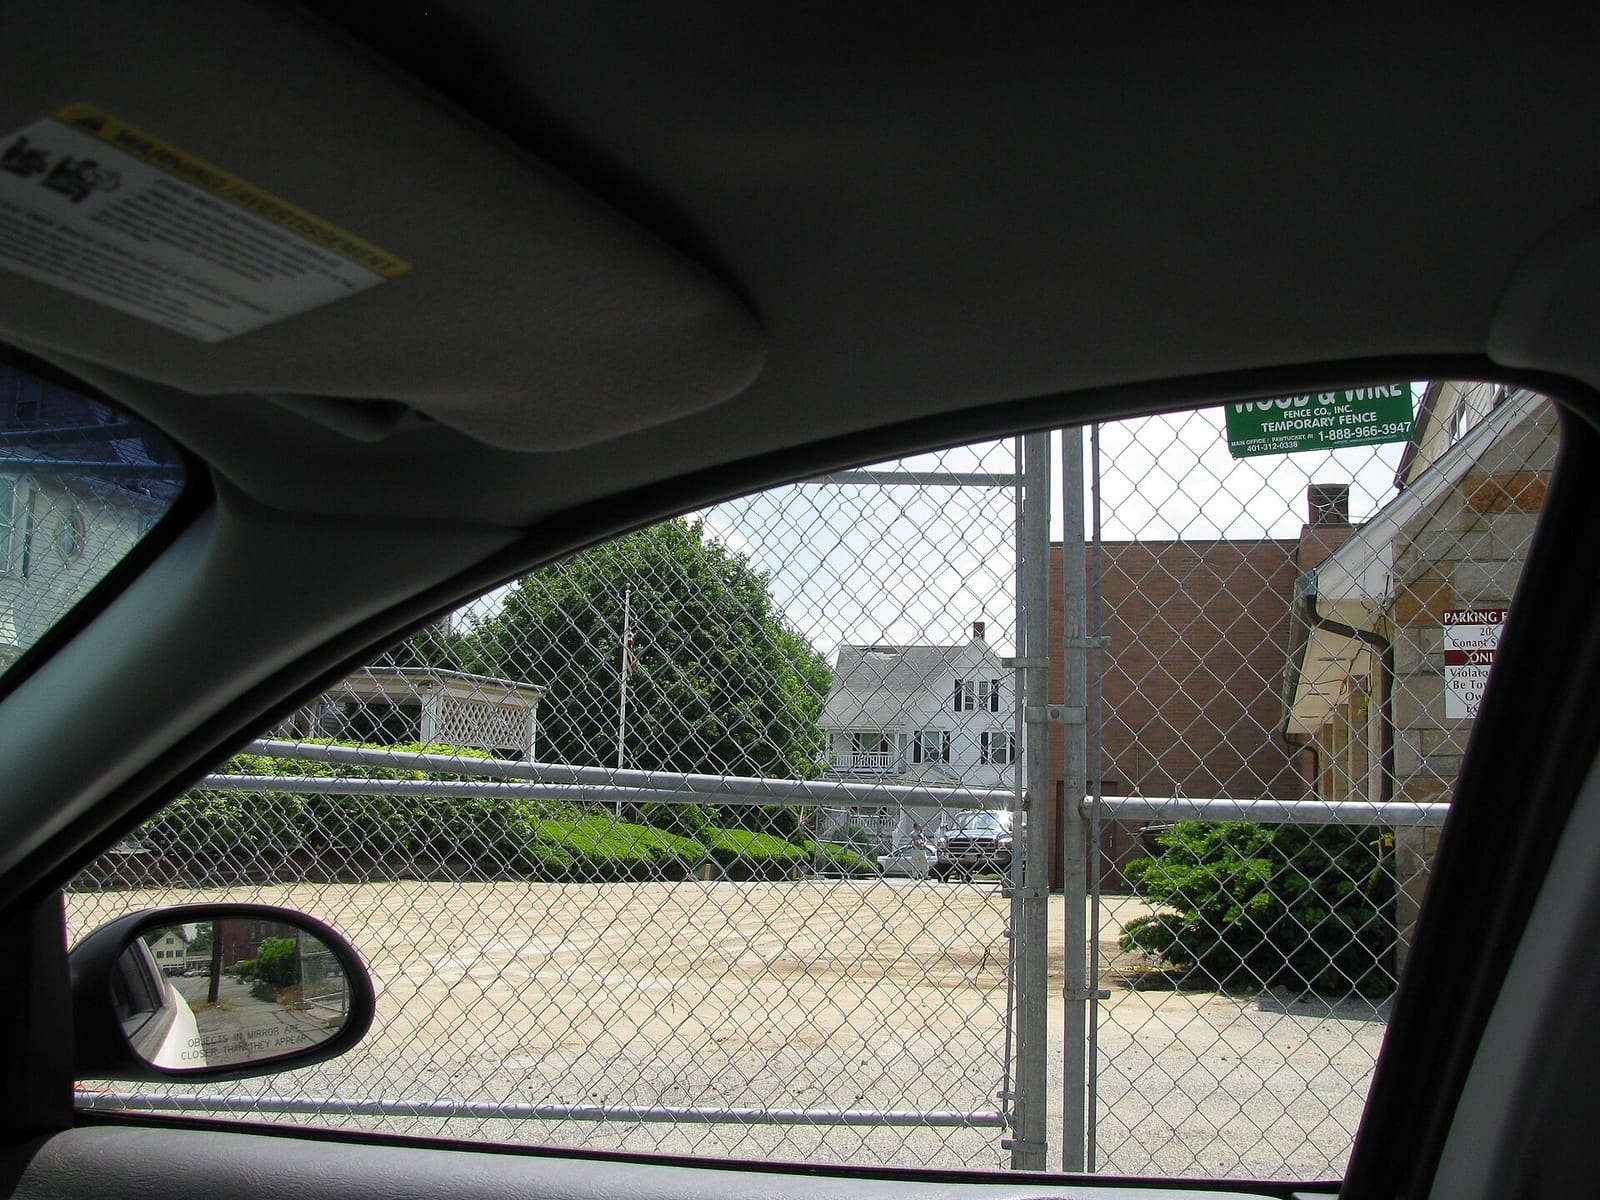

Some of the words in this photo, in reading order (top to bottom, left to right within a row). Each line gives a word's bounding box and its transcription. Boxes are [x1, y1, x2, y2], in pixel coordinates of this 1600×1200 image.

[1284, 408, 1312, 419] FENCE
[1334, 404, 1353, 414] INC.
[1261, 416, 1335, 433] TEMPORARY
[1339, 411, 1377, 425] FENCE
[1318, 421, 1412, 442] 1-888-966-3947
[1247, 440, 1298, 452] 401-312-0338
[1444, 611, 1497, 623] PARKING
[1452, 638, 1488, 648] Conant
[1453, 680, 1466, 689] Be
[187, 1034, 229, 1048] OBJECTS
[232, 1033, 243, 1042] IN
[247, 1028, 280, 1040] MIRROR
[284, 1024, 300, 1034] ARE
[181, 1048, 217, 1061] CLOSER
[224, 1043, 247, 1054] THAN
[249, 1040, 271, 1050] THEY
[275, 1034, 306, 1047] APPEAR
